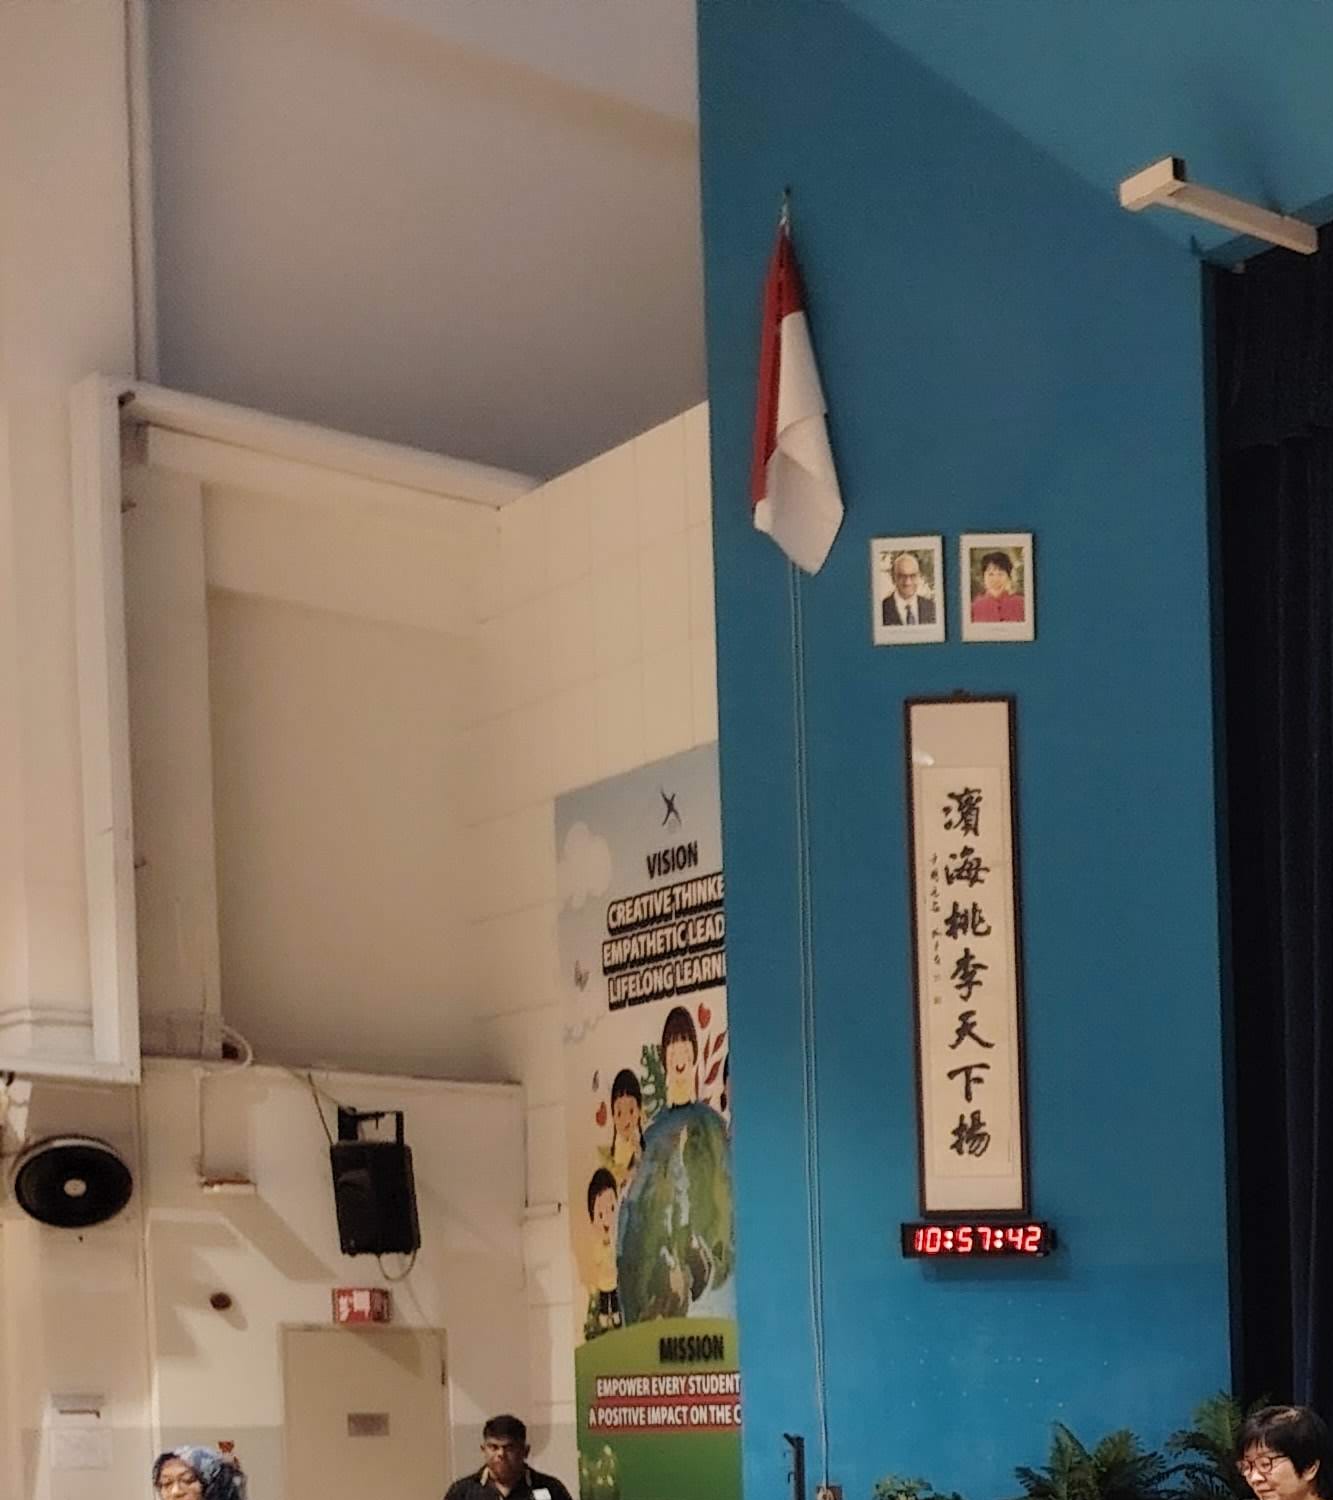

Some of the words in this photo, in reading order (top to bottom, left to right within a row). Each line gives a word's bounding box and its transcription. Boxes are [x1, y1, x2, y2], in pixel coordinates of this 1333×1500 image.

[646, 840, 699, 879] VISION
[608, 887, 673, 930] CREATIVE
[602, 922, 688, 966] EMPATHETIC
[608, 961, 674, 1003] LIFELONG
[915, 1226, 1041, 1253] 10:57:42
[660, 1334, 724, 1363] MISSION
[596, 1376, 650, 1397] EMPOWER
[651, 1375, 686, 1396] EVERY
[688, 1373, 740, 1395] STUDENT
[589, 1407, 597, 1426] A
[598, 1406, 646, 1426] POSITIVE
[647, 1405, 689, 1426] IMPACT
[690, 1405, 707, 1425] ON
[708, 1404, 733, 1425] THE
